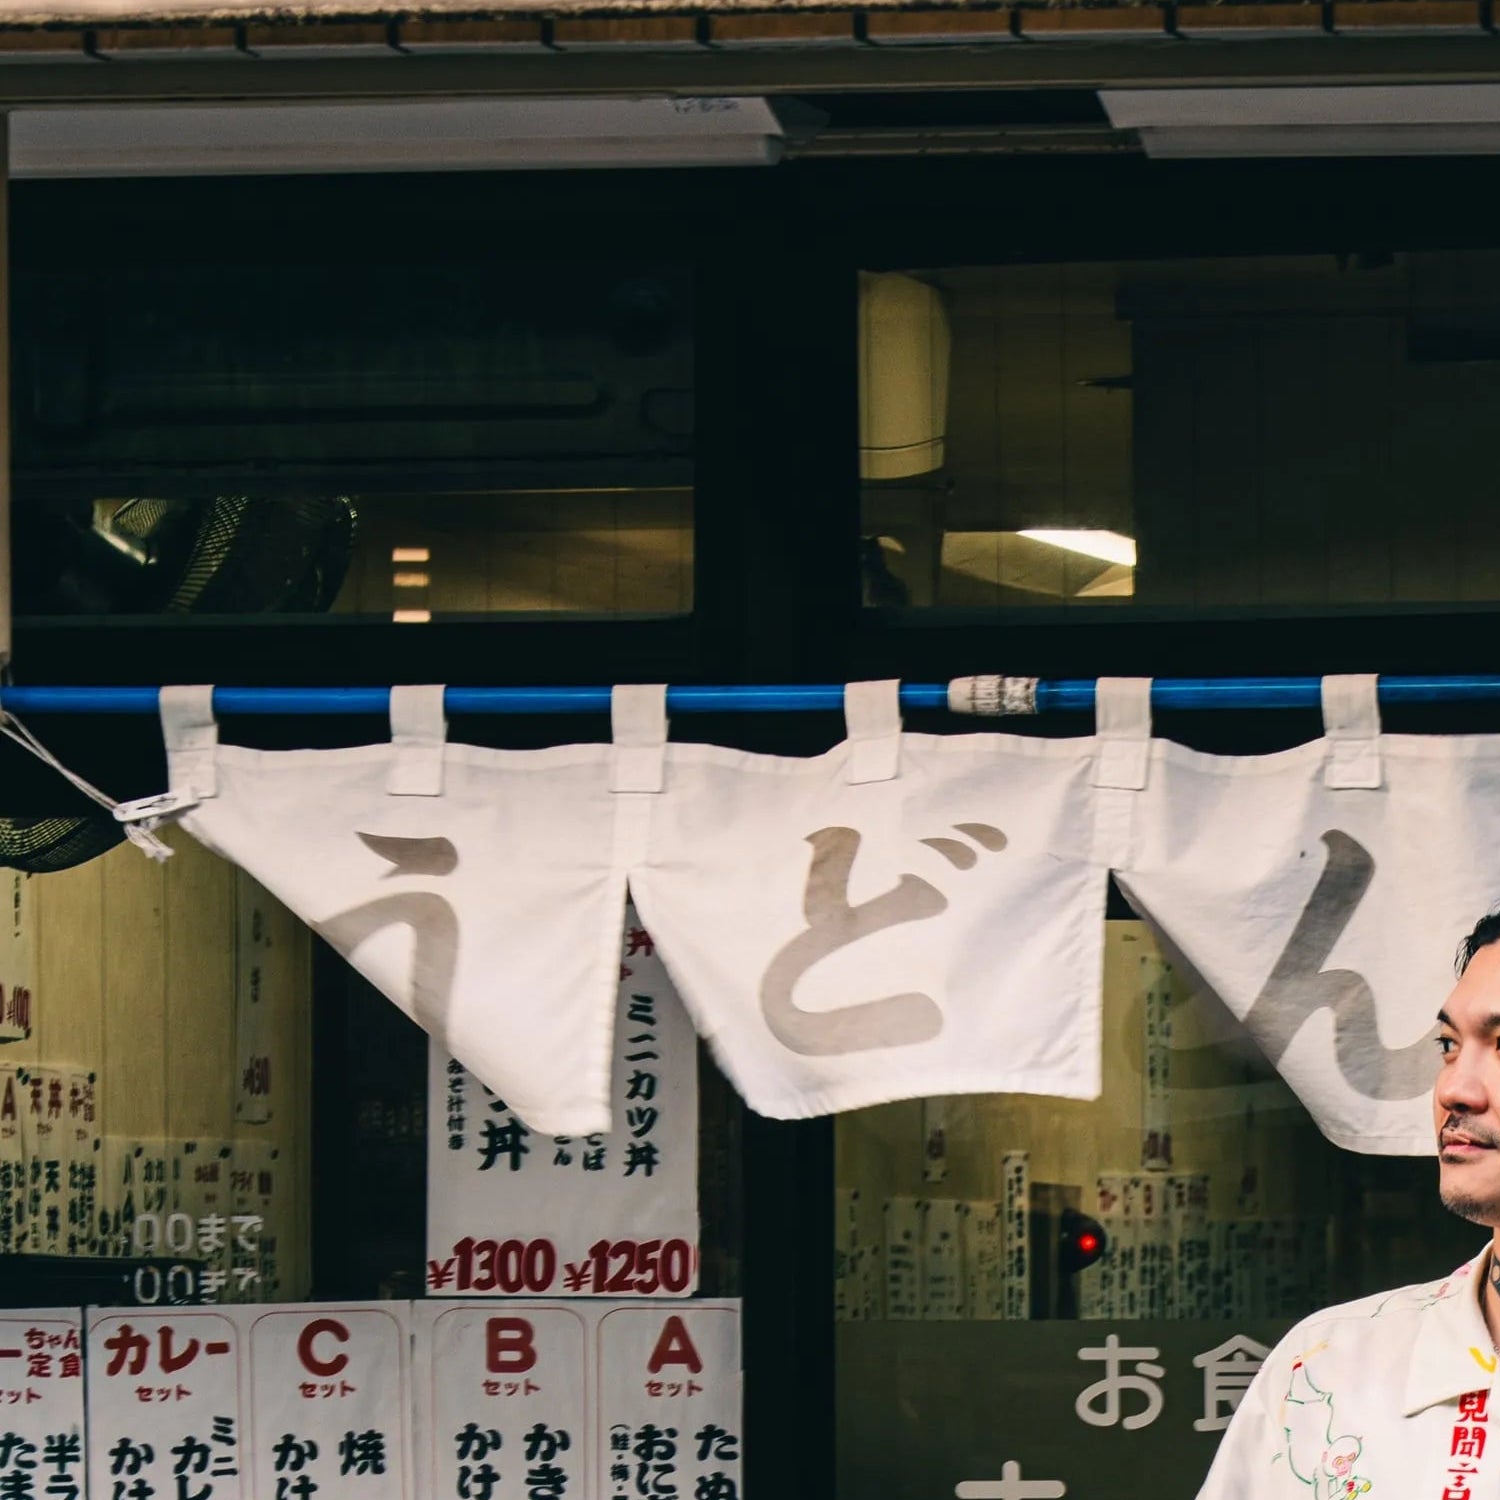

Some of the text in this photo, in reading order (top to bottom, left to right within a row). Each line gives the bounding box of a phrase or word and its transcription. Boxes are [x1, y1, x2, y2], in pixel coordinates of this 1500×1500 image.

[625, 995, 658, 1176] ミニカツ丼
[426, 1235, 557, 1294] ¥1300
[563, 1237, 690, 1294] ¥1250
[104, 1324, 229, 1376] カレー
[298, 1319, 349, 1376] C
[487, 1318, 536, 1373] B
[649, 1316, 702, 1373] A
[0, 1386, 43, 1406] ット
[136, 1386, 191, 1402] セット
[299, 1381, 355, 1398] セット
[483, 1380, 539, 1395] セット
[646, 1381, 702, 1396] セット
